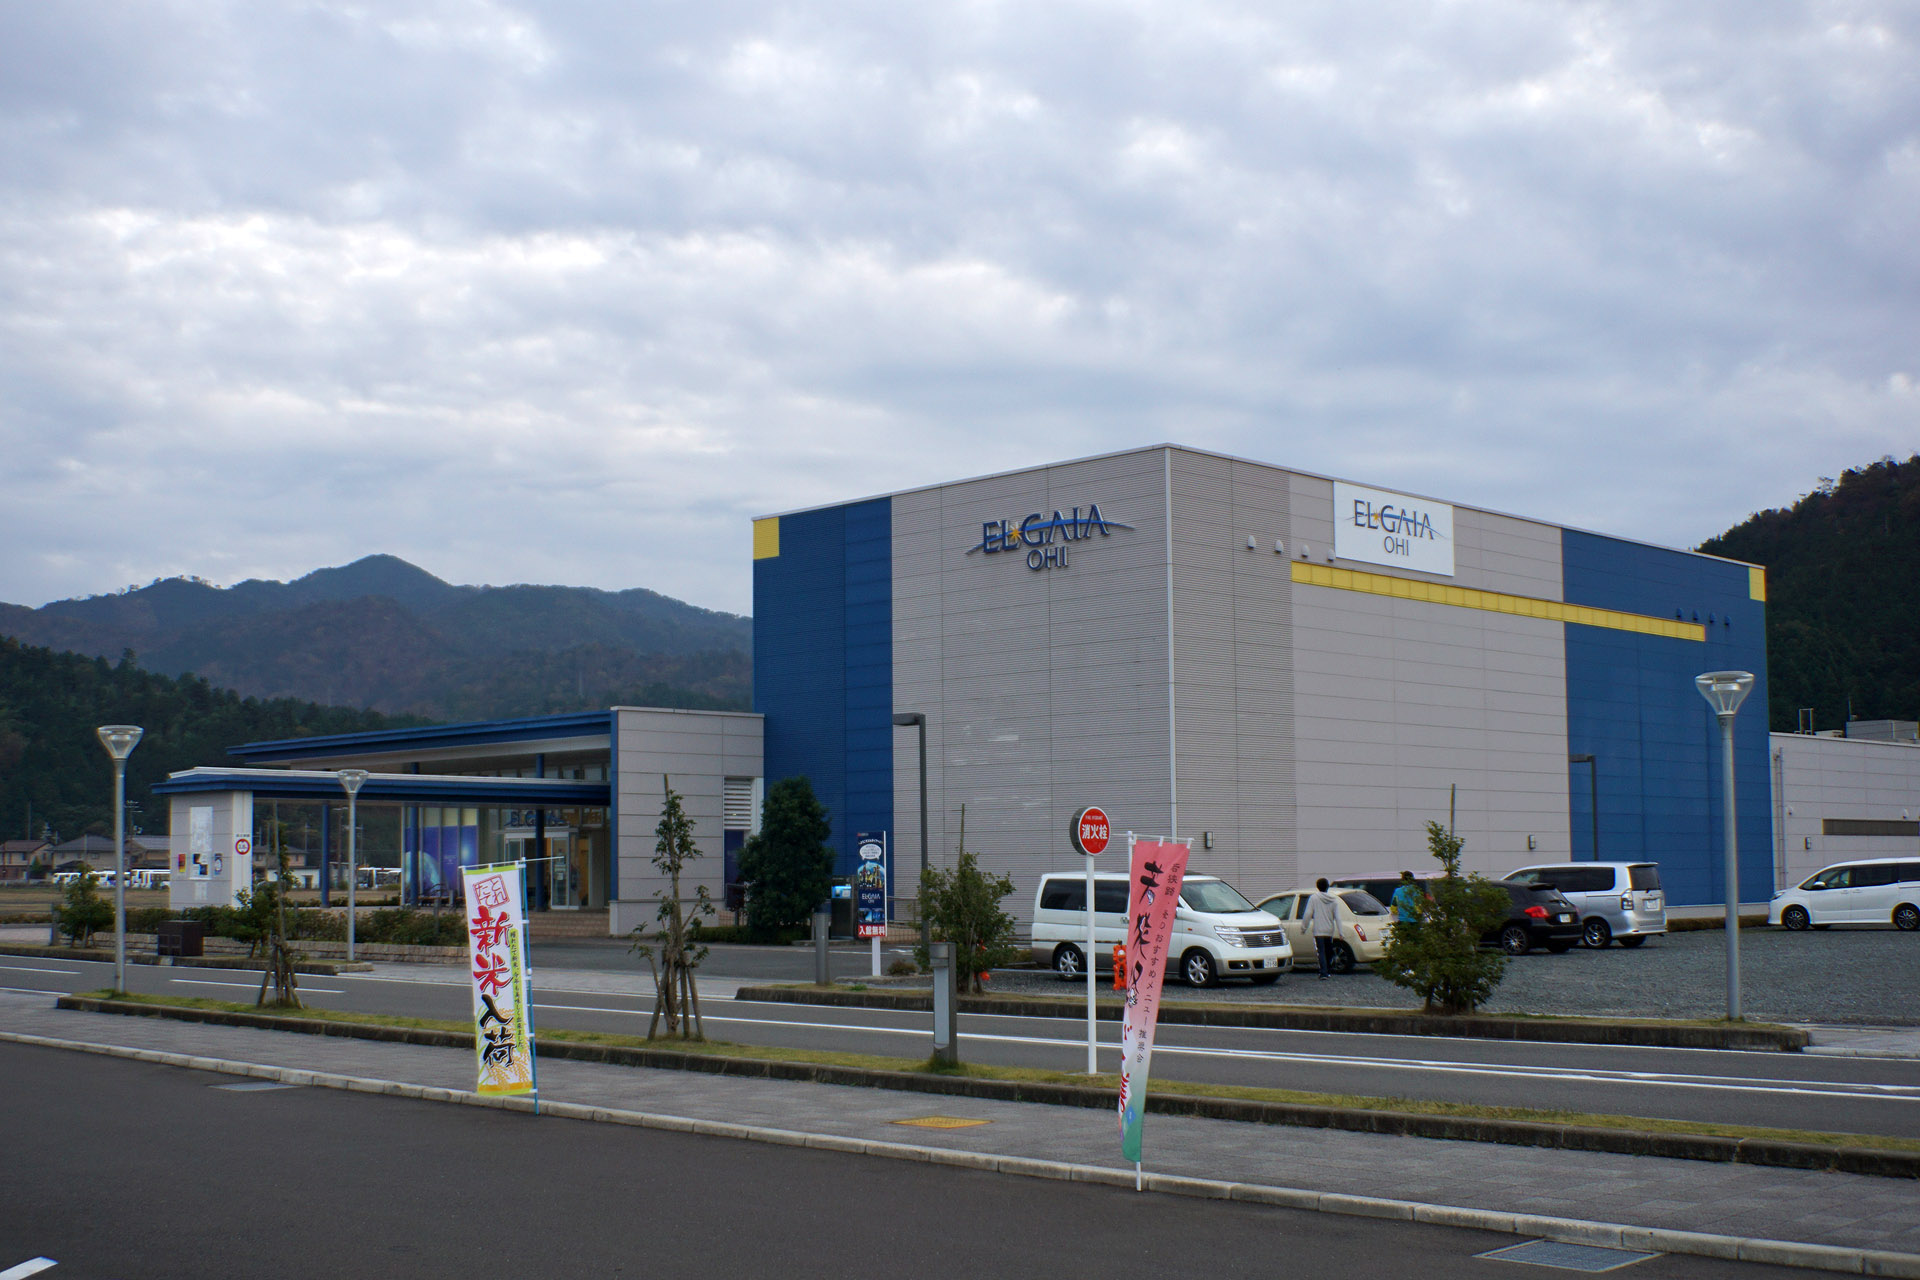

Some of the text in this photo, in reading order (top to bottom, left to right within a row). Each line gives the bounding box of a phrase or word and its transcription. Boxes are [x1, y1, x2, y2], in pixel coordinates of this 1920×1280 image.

[982, 503, 1110, 554] ELGAIA
[1353, 498, 1435, 541] ELGAIA
[1026, 545, 1069, 571] OHI
[1383, 535, 1410, 557] OHI
[1081, 823, 1108, 840] 消火栓
[470, 905, 517, 1068] 新米入荷
